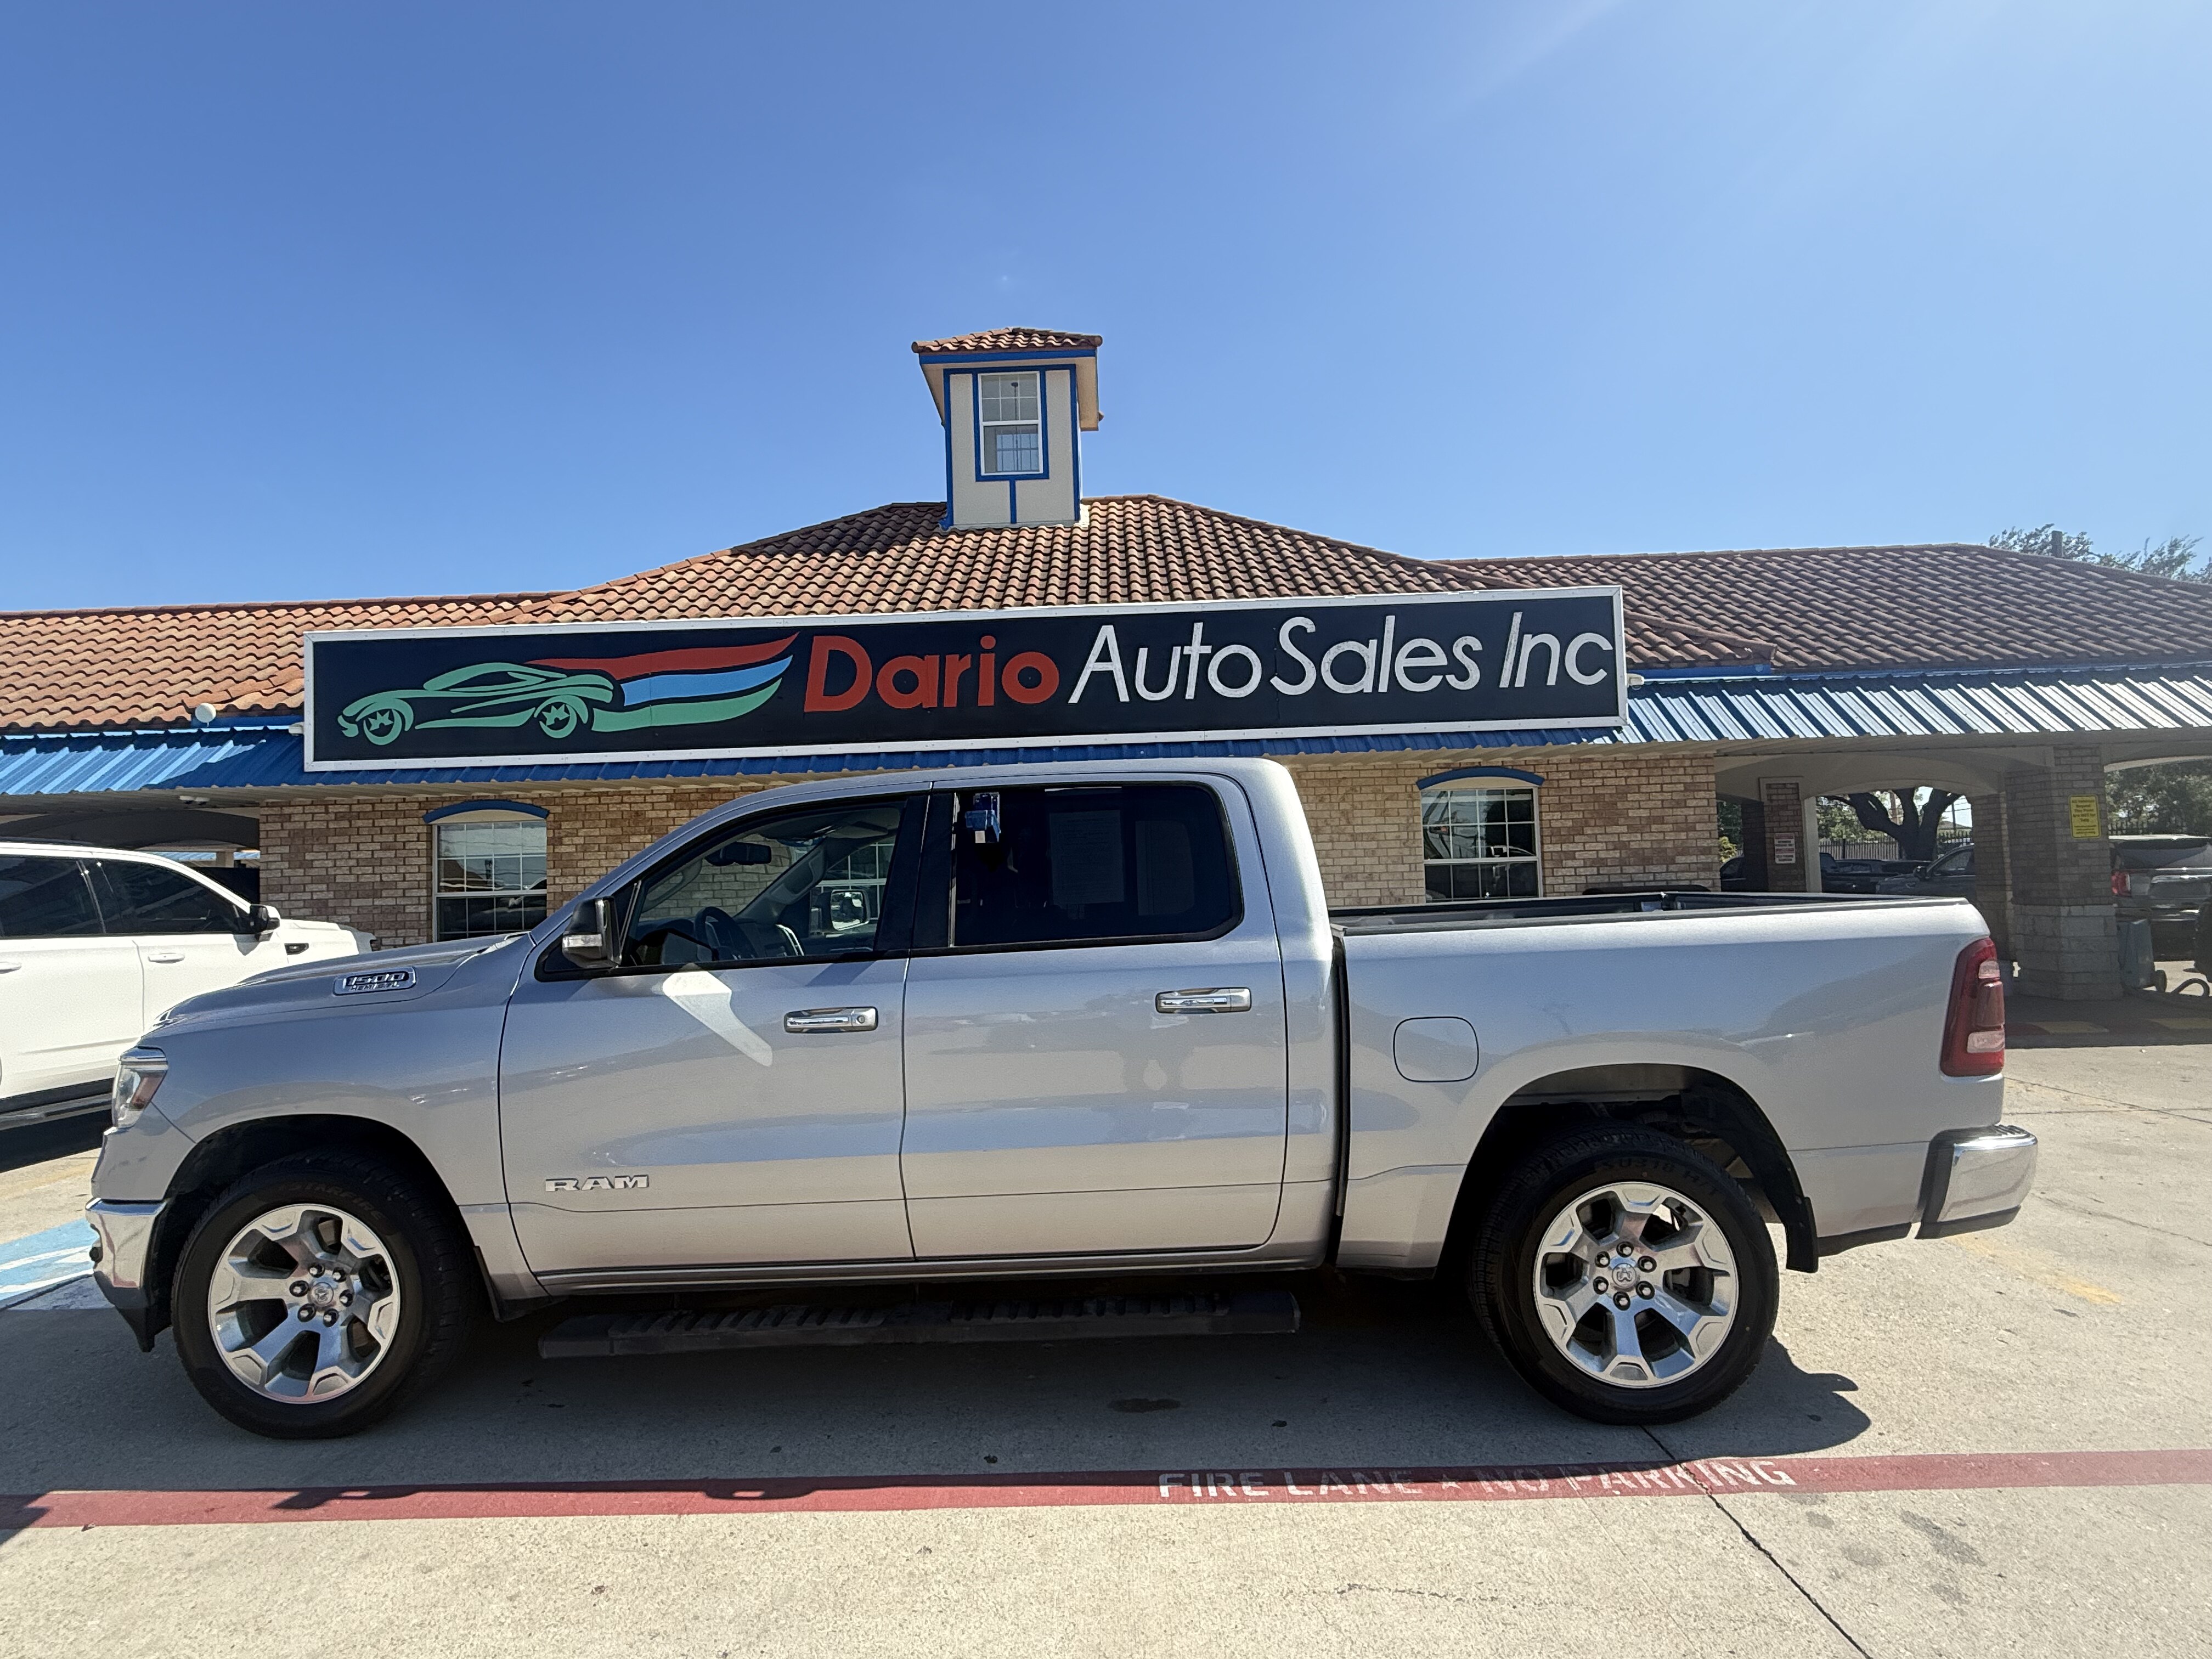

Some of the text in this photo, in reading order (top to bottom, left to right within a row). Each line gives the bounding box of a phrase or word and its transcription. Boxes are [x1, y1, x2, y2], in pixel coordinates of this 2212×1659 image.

[804, 611, 1614, 712] Dario Auto Sales Inc
[348, 973, 405, 986] 1500
[545, 1174, 650, 1192] RAM
[1158, 1460, 1798, 1498] FIRE LANE NO PARKING
